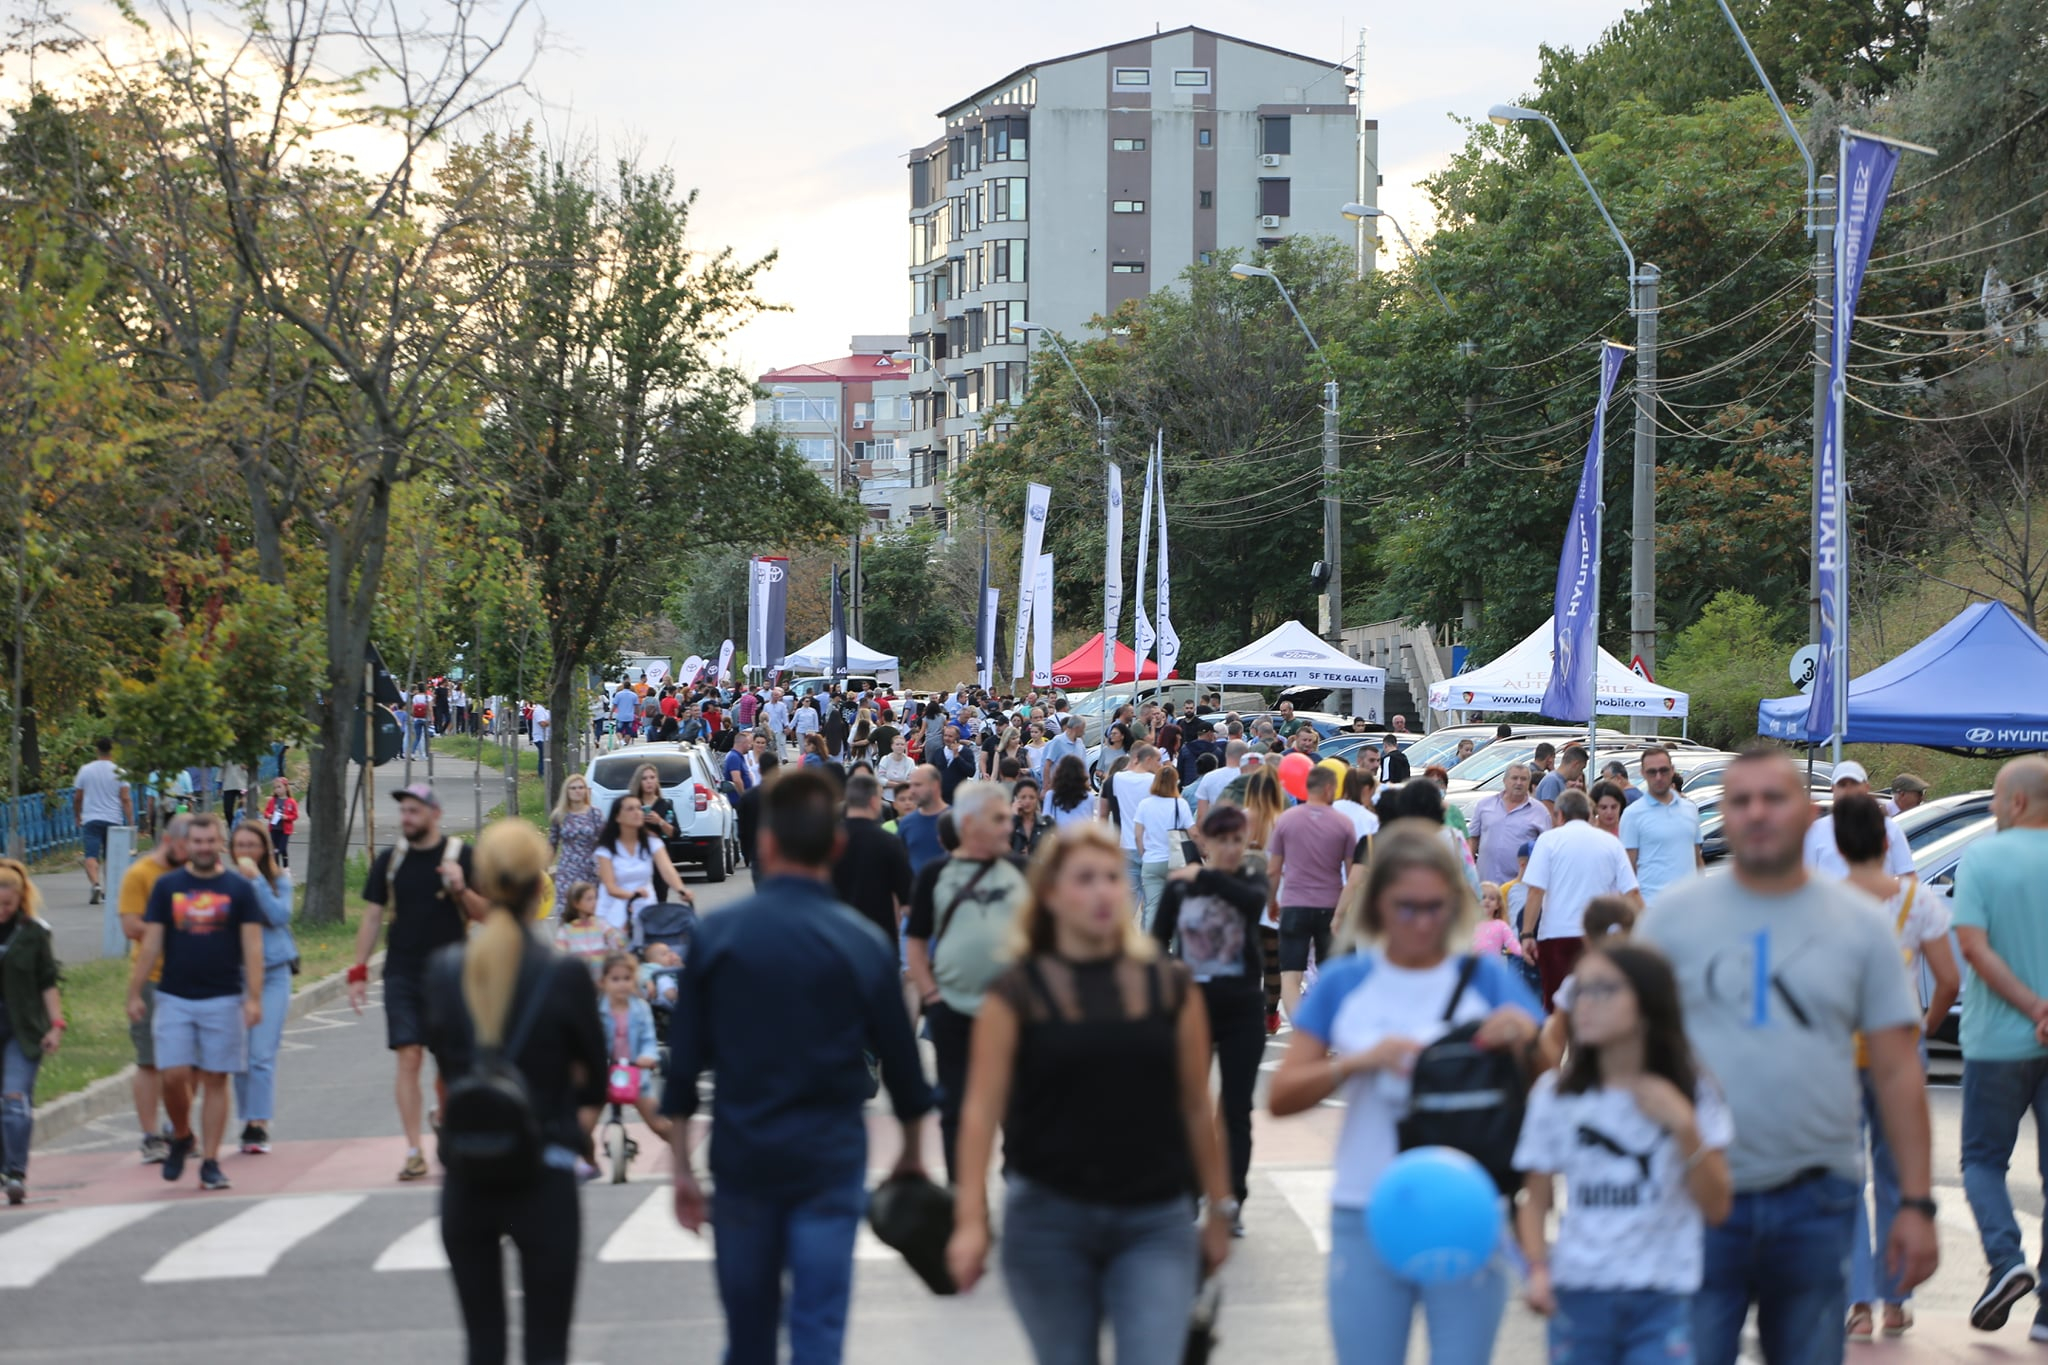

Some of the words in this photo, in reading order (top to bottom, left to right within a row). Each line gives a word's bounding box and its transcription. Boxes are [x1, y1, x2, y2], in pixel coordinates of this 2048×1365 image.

[1819, 421, 1836, 570] HYUN
[1227, 670, 1240, 678] SF
[1241, 670, 1261, 678] TEX
[1308, 671, 1321, 680] SF
[1323, 673, 1342, 681] TEX
[1802, 657, 1818, 681] 3
